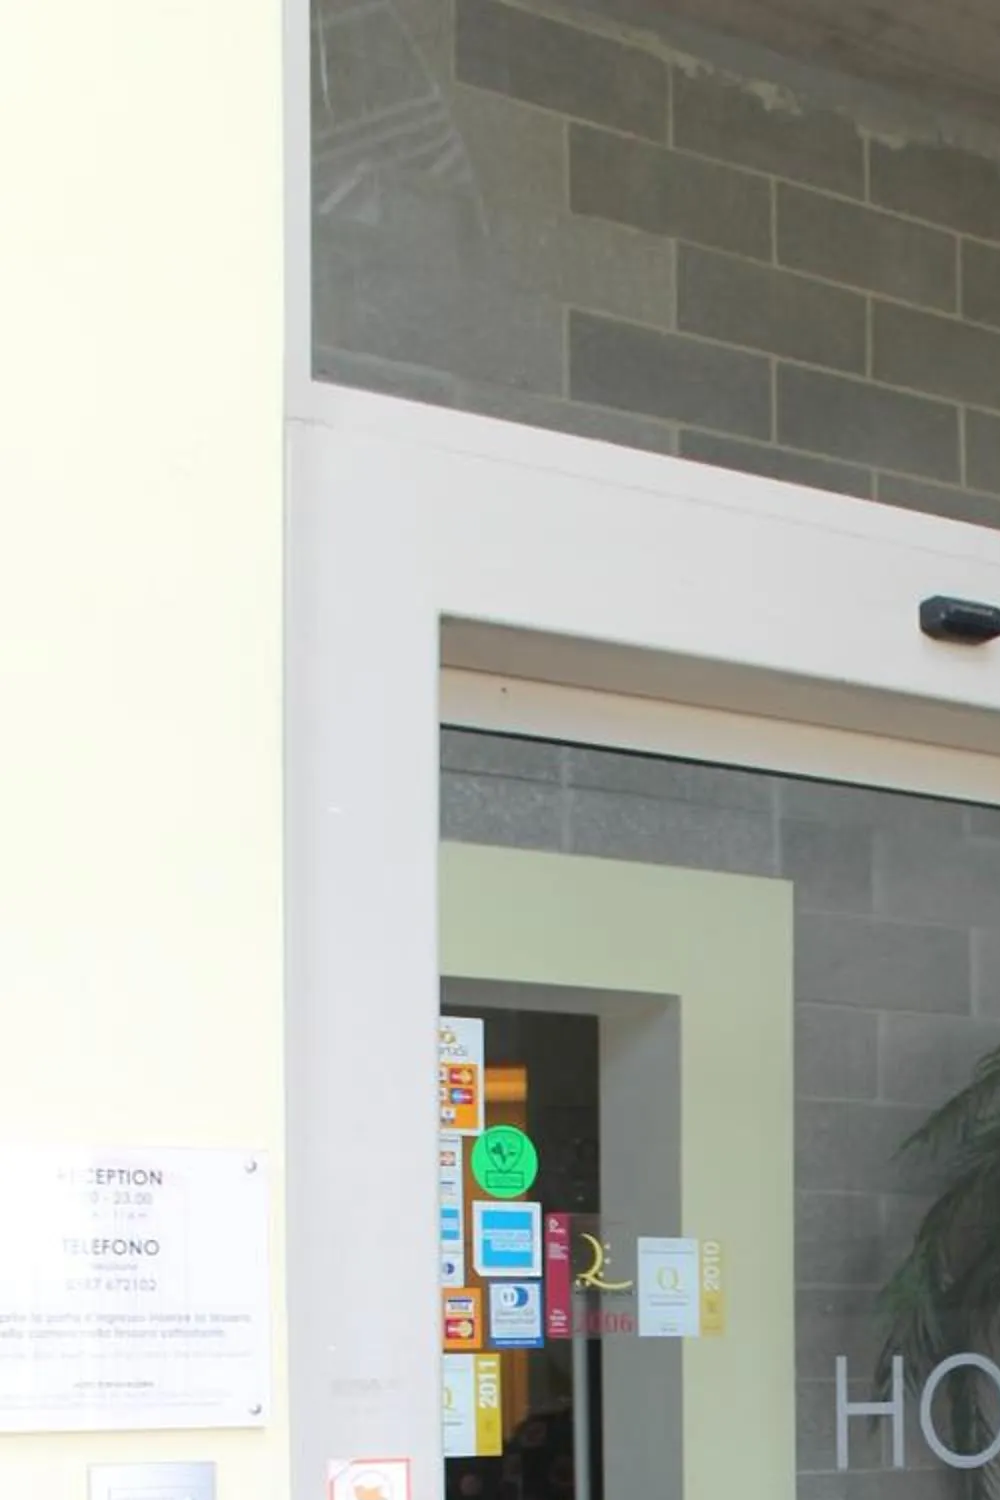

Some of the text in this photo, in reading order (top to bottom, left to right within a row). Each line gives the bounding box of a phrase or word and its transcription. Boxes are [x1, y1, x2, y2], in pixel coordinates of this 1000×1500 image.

[58, 1168, 163, 1186] EPTION
[702, 1240, 721, 1291] 2010
[478, 1360, 498, 1408] 2011
